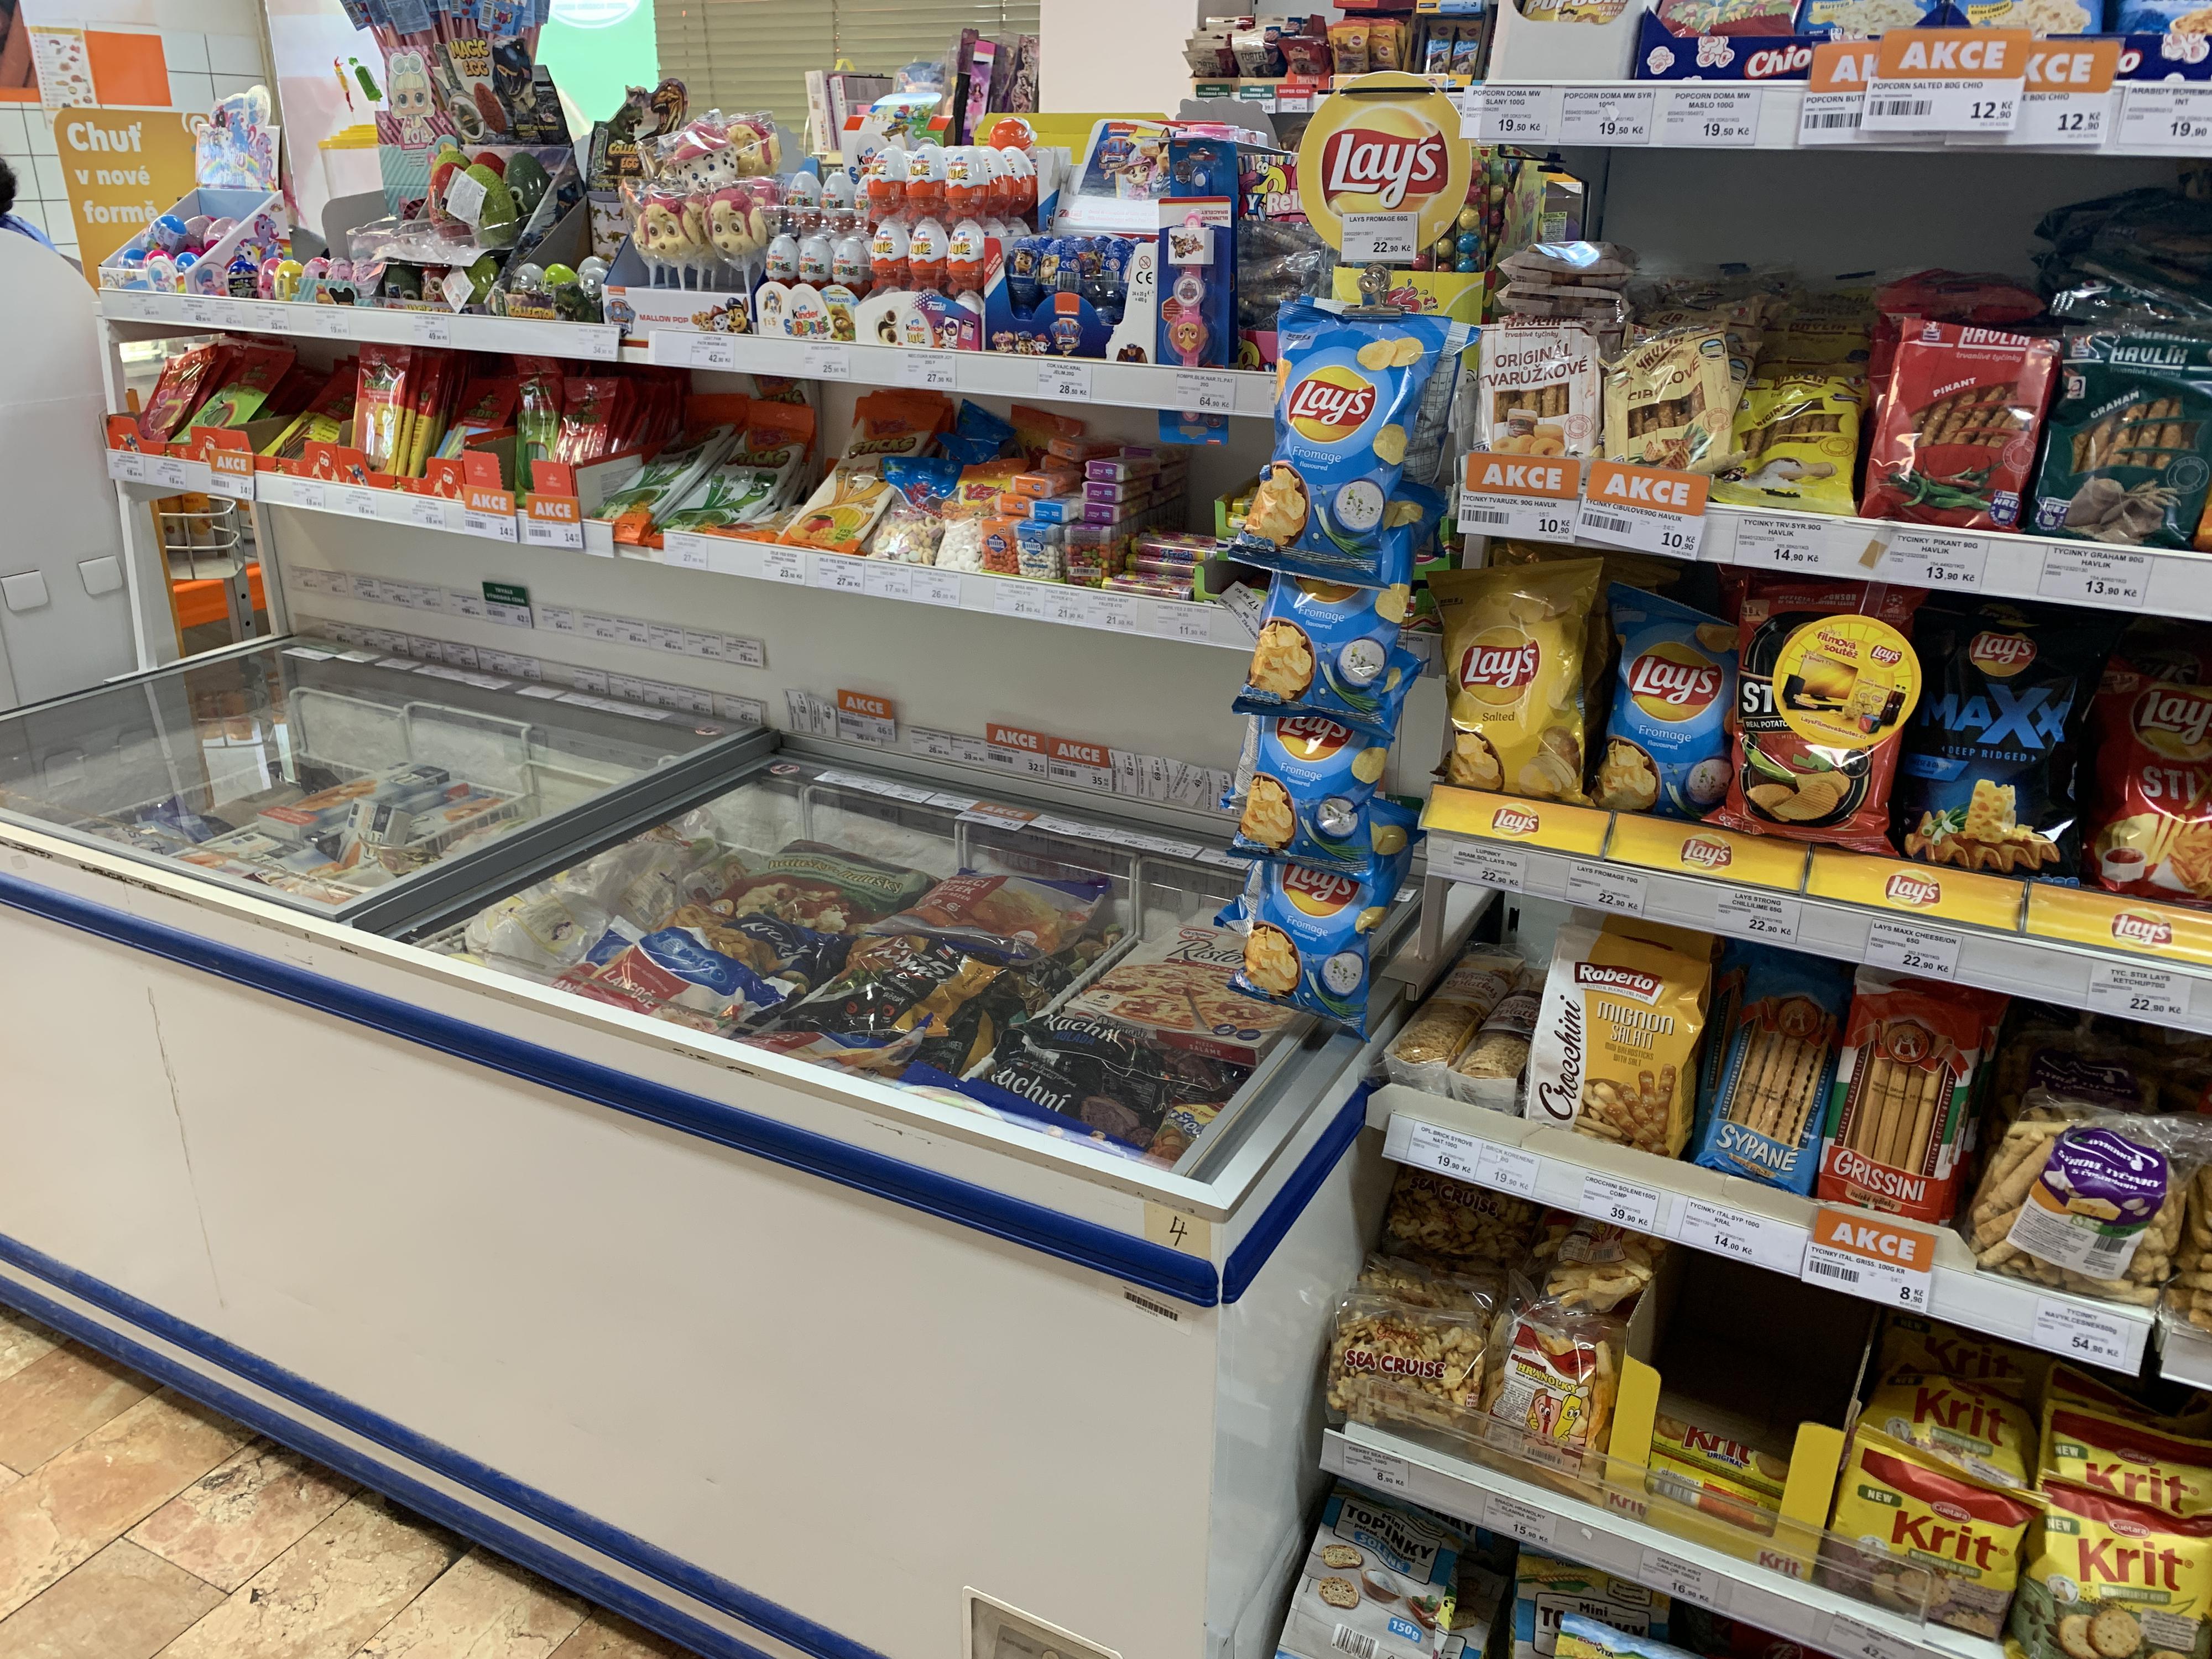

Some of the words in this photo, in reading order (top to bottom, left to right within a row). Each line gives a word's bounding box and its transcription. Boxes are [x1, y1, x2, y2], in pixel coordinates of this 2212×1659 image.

[449, 39, 489, 59] MAGIC
[1240, 51, 1267, 61] FORTEL
[1898, 41, 2007, 69] AKCE
[462, 60, 489, 77] EGG
[1747, 45, 1811, 77] Chio
[2026, 54, 2095, 82] KCE
[1499, 119, 1526, 132] 19,50
[1599, 123, 1628, 135] 19,50
[67, 121, 143, 152] Chuť
[404, 133, 430, 144] LOL
[75, 169, 88, 185] v
[98, 165, 150, 186] nové
[1329, 134, 1441, 209] Lay's
[84, 201, 158, 223] formě
[1373, 242, 1398, 252] 22,90
[1136, 272, 1153, 284] CE
[639, 313, 671, 323] MALLOW
[673, 316, 688, 324] POP
[792, 309, 818, 319] kinder
[784, 316, 831, 336] SURPRISE
[907, 333, 925, 344] JOY
[1496, 341, 1573, 368] ORIGINÁL
[2110, 346, 2188, 366] HAVLÍK
[1060, 385, 1078, 395] 28,50
[1933, 377, 1976, 397] PIKANT
[1199, 397, 1219, 407] 64,90
[1291, 380, 1373, 425] Lay's
[2090, 391, 2140, 419] GRAHAM
[848, 439, 916, 458] STICKS
[1292, 446, 1342, 463] Fromage
[217, 456, 246, 472] AKCE
[1300, 461, 1328, 471] flavoured
[1482, 463, 1562, 490] AKCE
[1604, 473, 1690, 506] AKCE
[471, 494, 507, 510] AKCE
[535, 502, 571, 518] AKCE
[1585, 499, 1611, 508] TYCINKY
[1613, 503, 1657, 517] CIBULOVE90G
[1658, 513, 1682, 521] HAVLIK
[987, 539, 1006, 549] mira
[1024, 541, 1044, 552] mira
[1774, 549, 1803, 561] 14,90
[2081, 560, 2111, 568] HAVLIK
[1926, 566, 1958, 581] 13,90
[2085, 581, 2119, 596] 13,90
[2124, 588, 2137, 597] Kč
[1298, 605, 1345, 623] Fromage
[1824, 644, 1858, 659] soutěž
[1974, 634, 2032, 664] Lay's
[1464, 645, 1535, 688] Lay's
[1634, 656, 1720, 705] Lay's
[846, 696, 884, 714] AKCE
[1482, 712, 1515, 722] Salted
[1922, 684, 2073, 749] MAXX
[995, 729, 1037, 749] AKCE
[1638, 725, 1692, 743] Fromage
[1057, 743, 1100, 763] AKCE
[1647, 739, 1678, 750] flavoured
[1948, 745, 1975, 757] DEEP
[1981, 749, 2027, 762] RIDGED
[1281, 761, 1323, 781] Fromage
[980, 806, 1027, 818] AKCE
[1494, 810, 1537, 832] Lay's
[1683, 839, 1730, 866] Lay's
[1481, 870, 1506, 884] 22,90
[1887, 873, 1940, 902] Lay's
[1599, 893, 1625, 907] 22,90
[1287, 915, 1328, 936] Fromage
[1749, 919, 1777, 933] 22,90
[2114, 913, 2172, 944] Lay's
[1903, 954, 1933, 970] 22,90
[1937, 963, 1948, 972] Kč
[1579, 964, 1653, 990] Roberto
[2130, 998, 2164, 1012] 22,90
[1597, 1001, 1674, 1035] MIGNON
[1610, 1025, 1653, 1050] SALATI
[1189, 1044, 1221, 1056] SALAME
[1540, 995, 1580, 1120] Crocchini
[1717, 1123, 1800, 1172] SYPANÉ
[1437, 1155, 1459, 1170] 19,90
[1494, 1171, 1517, 1186] 19,90
[1834, 1150, 1925, 1202] GRISSINI
[1611, 1207, 1636, 1223] 39,90
[1638, 1218, 1648, 1226] Kč
[1170, 1216, 1187, 1246] 4
[1714, 1234, 1739, 1251] 14,00
[1743, 1246, 1752, 1255] Kč
[1831, 1222, 1917, 1261] AKCE
[1812, 1247, 1837, 1259] TYCINKY
[1839, 1253, 1854, 1261] ITAL.
[1856, 1258, 1876, 1267] GRISS.
[1879, 1263, 1895, 1271] 100G
[1345, 1350, 1375, 1369] SEA
[1381, 1355, 1445, 1379] CRUISE
[1516, 1362, 1579, 1394] HRANOLKY
[1913, 1387, 2004, 1447] Krit
[1683, 1426, 1754, 1465] Krit
[1868, 1489, 1892, 1504] NEW
[2086, 1462, 2188, 1515] Krit
[1609, 1492, 1646, 1517] Krit
[1934, 1504, 1969, 1521] Cuetara
[1347, 1504, 1434, 1559] TOPINKY
[1382, 1513, 1405, 1532] Mini
[2047, 1517, 2072, 1531] NEW
[2112, 1522, 2147, 1535] Cuetara
[1891, 1510, 1997, 1571] Krit
[1759, 1551, 1802, 1578] Krit
[2078, 1537, 2182, 1592] Krit
[1579, 1603, 1609, 1616] Mini
[1392, 1620, 1420, 1641] 150g
